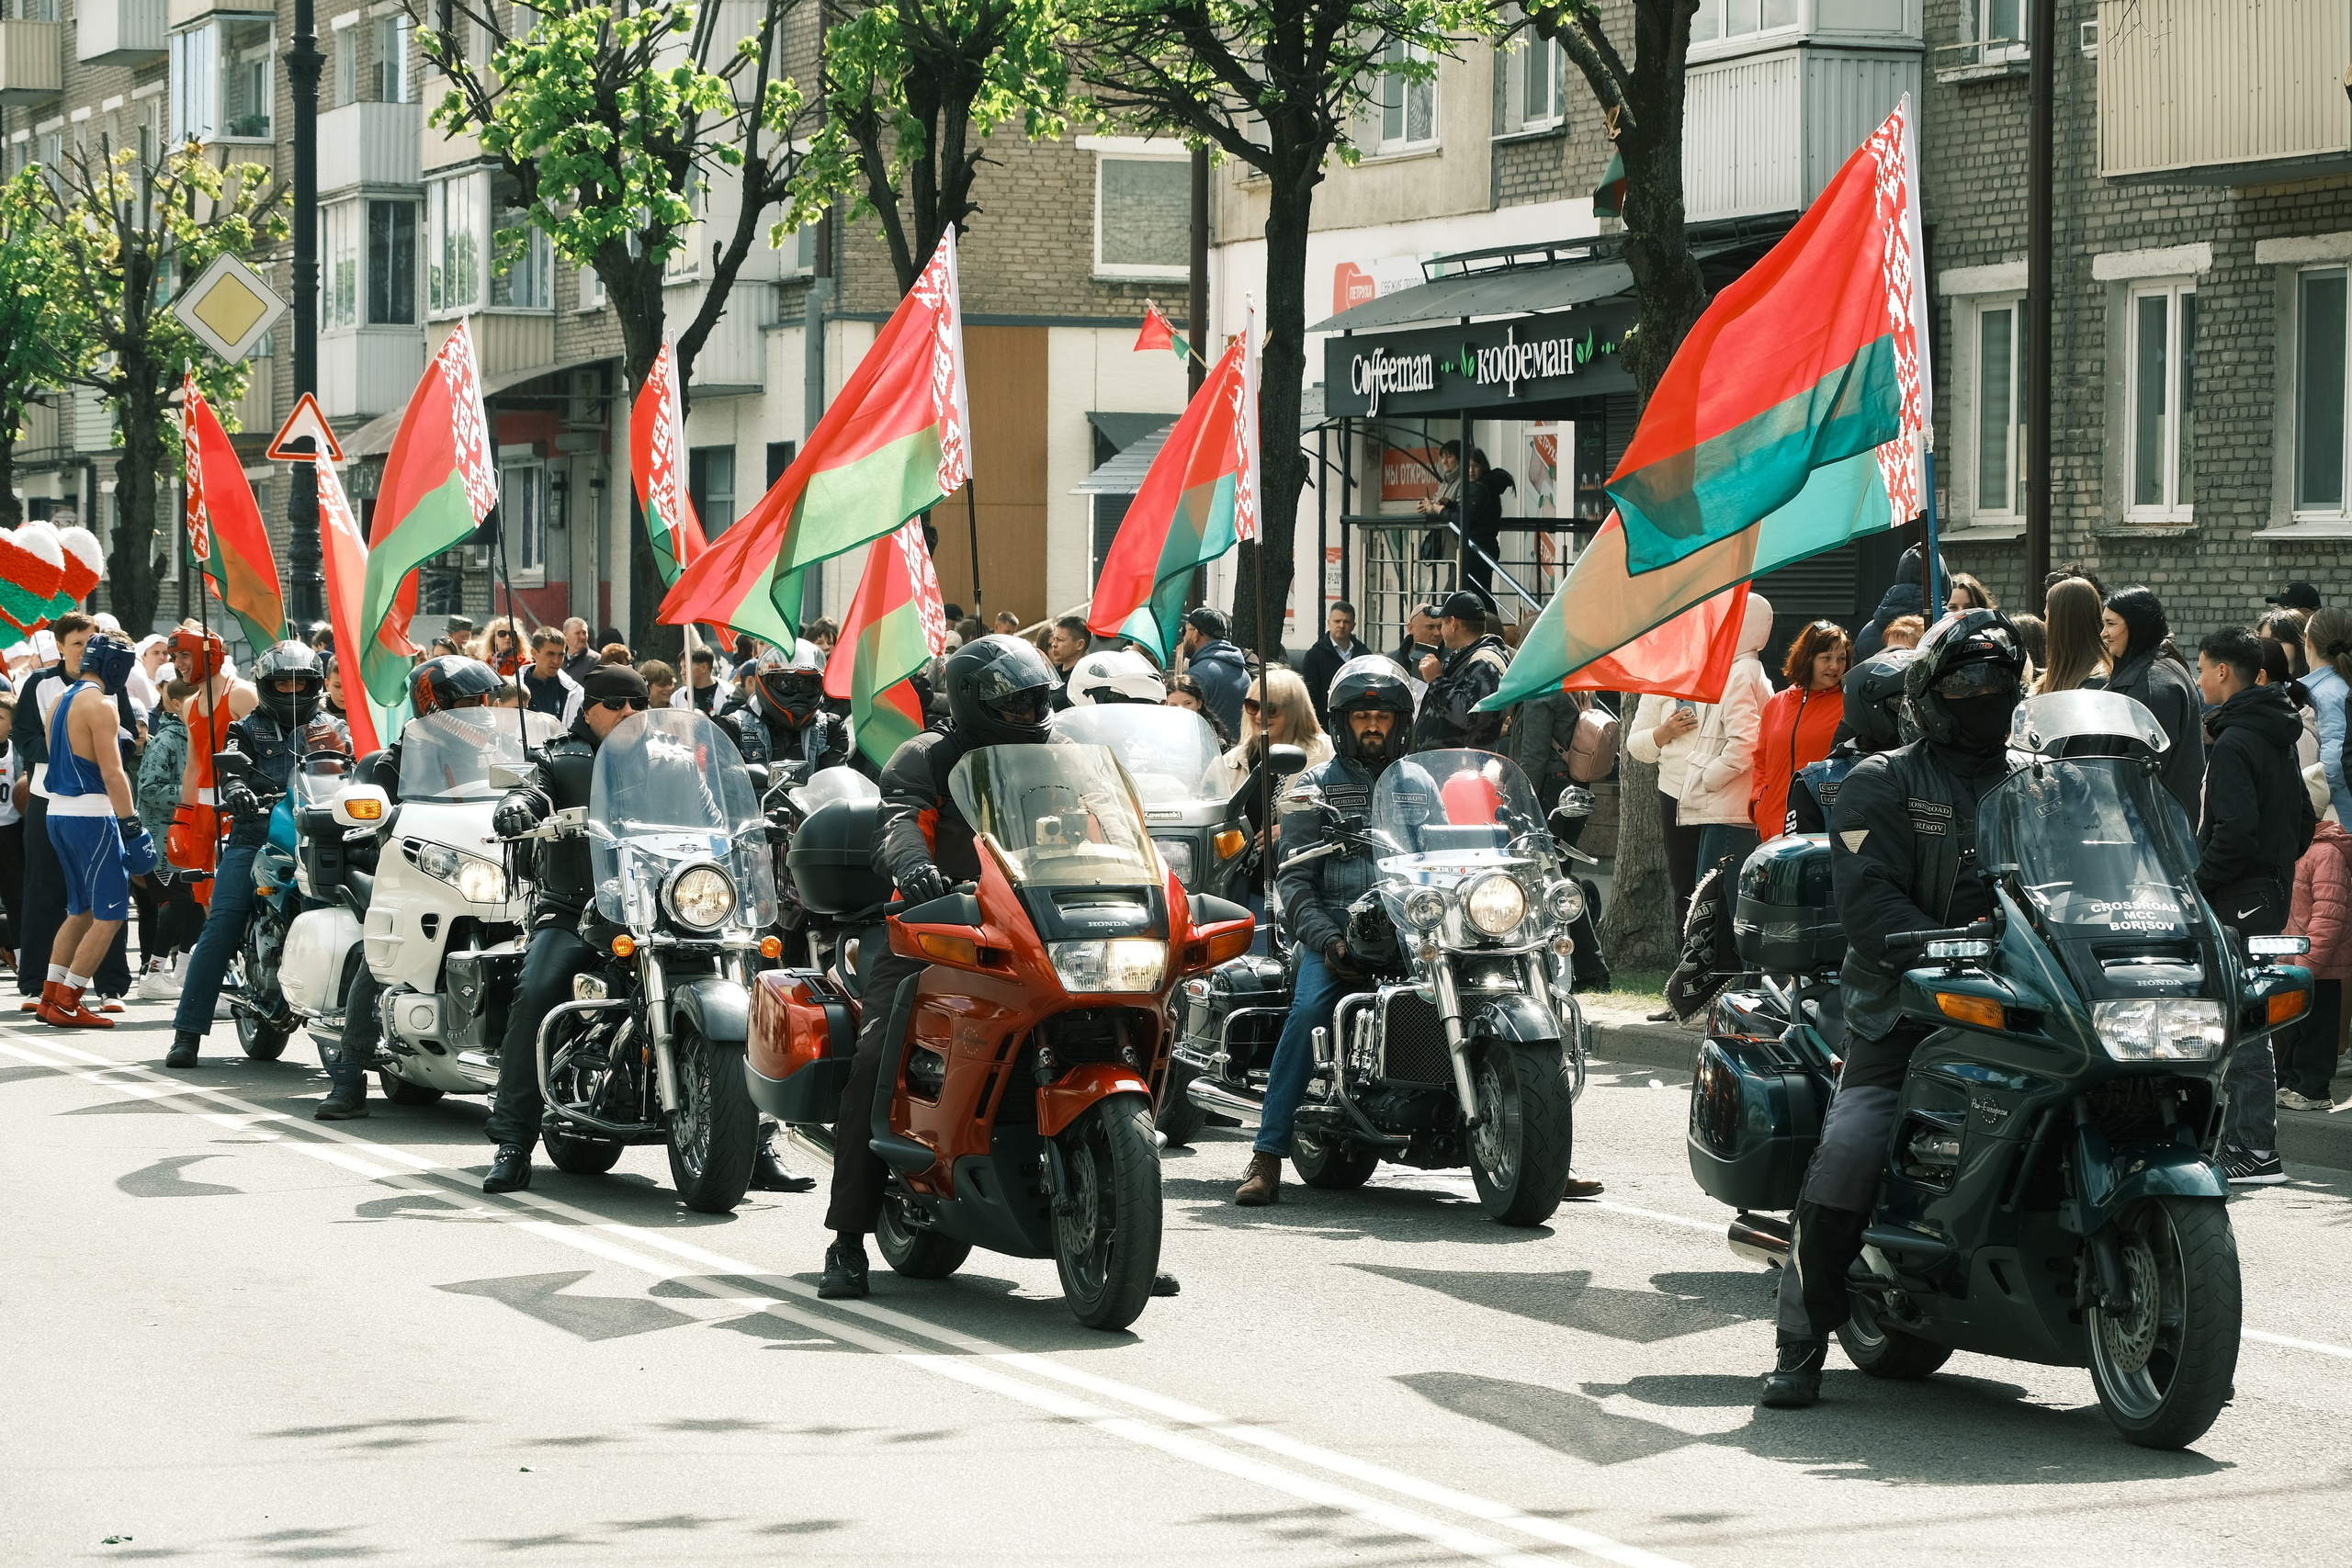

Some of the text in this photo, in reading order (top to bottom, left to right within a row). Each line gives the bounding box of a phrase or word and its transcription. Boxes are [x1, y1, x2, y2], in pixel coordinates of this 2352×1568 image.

[1349, 285, 1373, 299] ПЕТРУХА
[1476, 325, 1574, 397] кофеман
[1351, 347, 1433, 418] Coffeeman
[1385, 465, 1398, 485] МЫ
[2091, 901, 2180, 913] CROSSROAD
[2123, 911, 2156, 919] MCC
[2109, 920, 2175, 931] BORISOV
